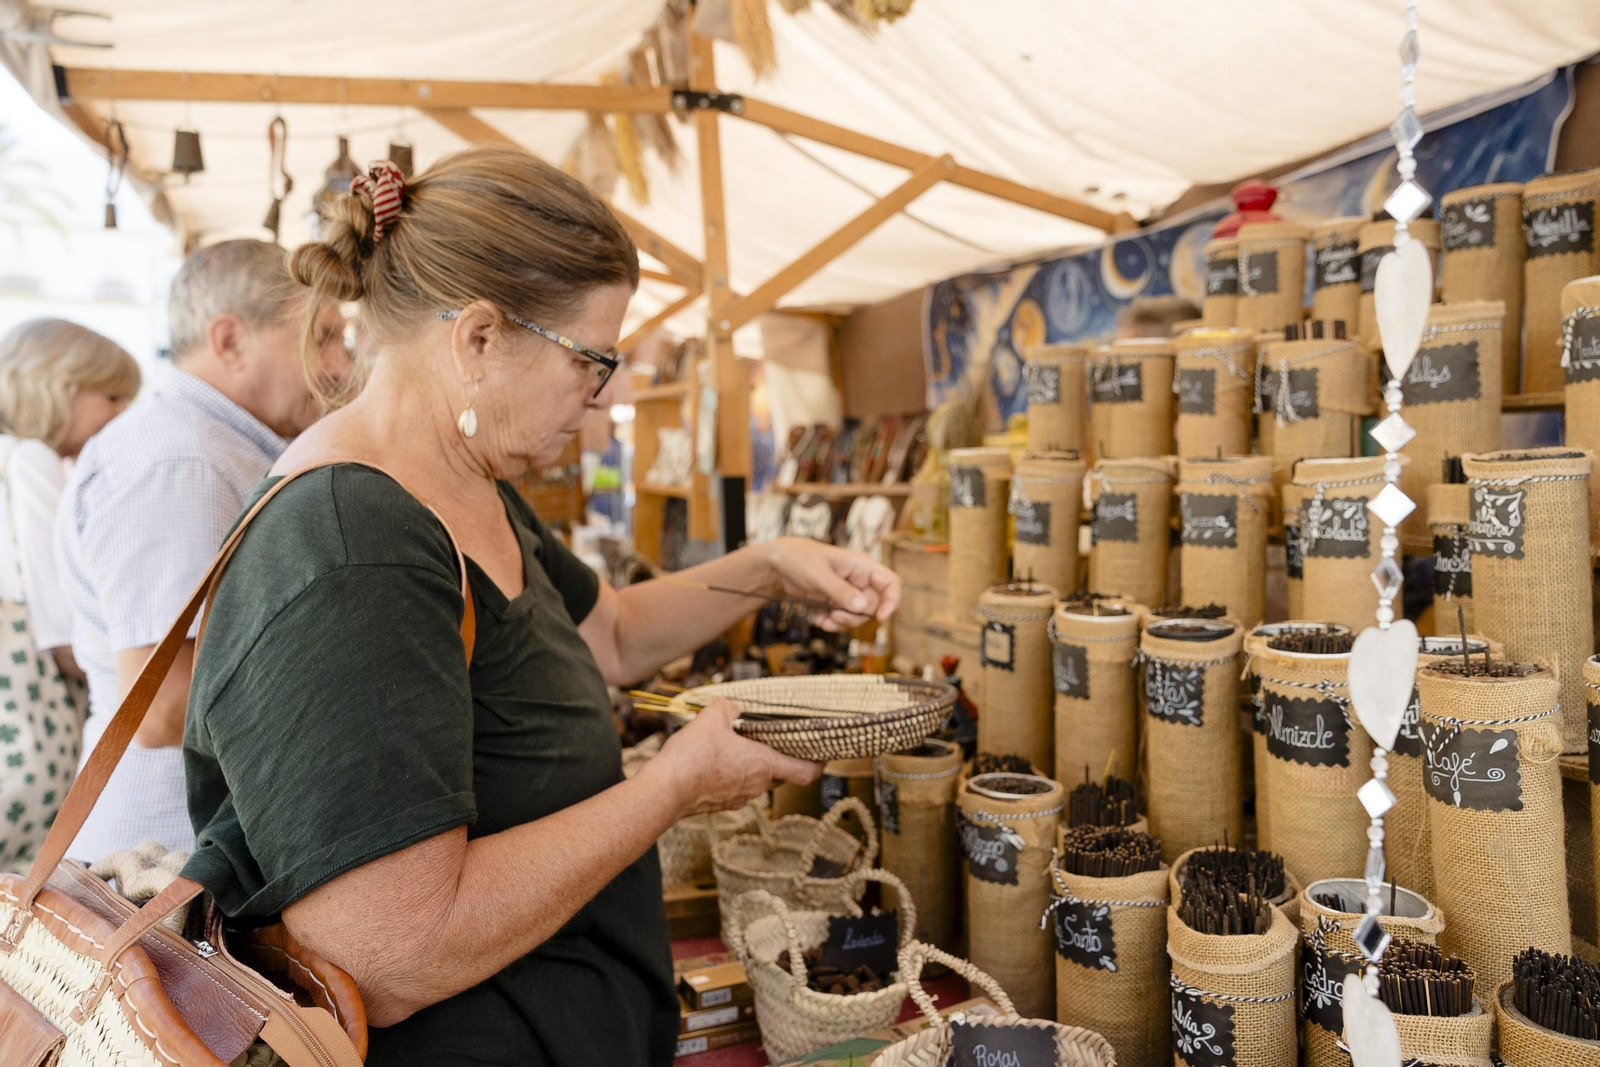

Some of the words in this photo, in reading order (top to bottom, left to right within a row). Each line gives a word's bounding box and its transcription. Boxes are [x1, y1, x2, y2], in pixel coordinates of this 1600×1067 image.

[1266, 703, 1335, 749] Almizcle
[1059, 913, 1102, 953] Santo
[1305, 962, 1344, 998] Cedro
